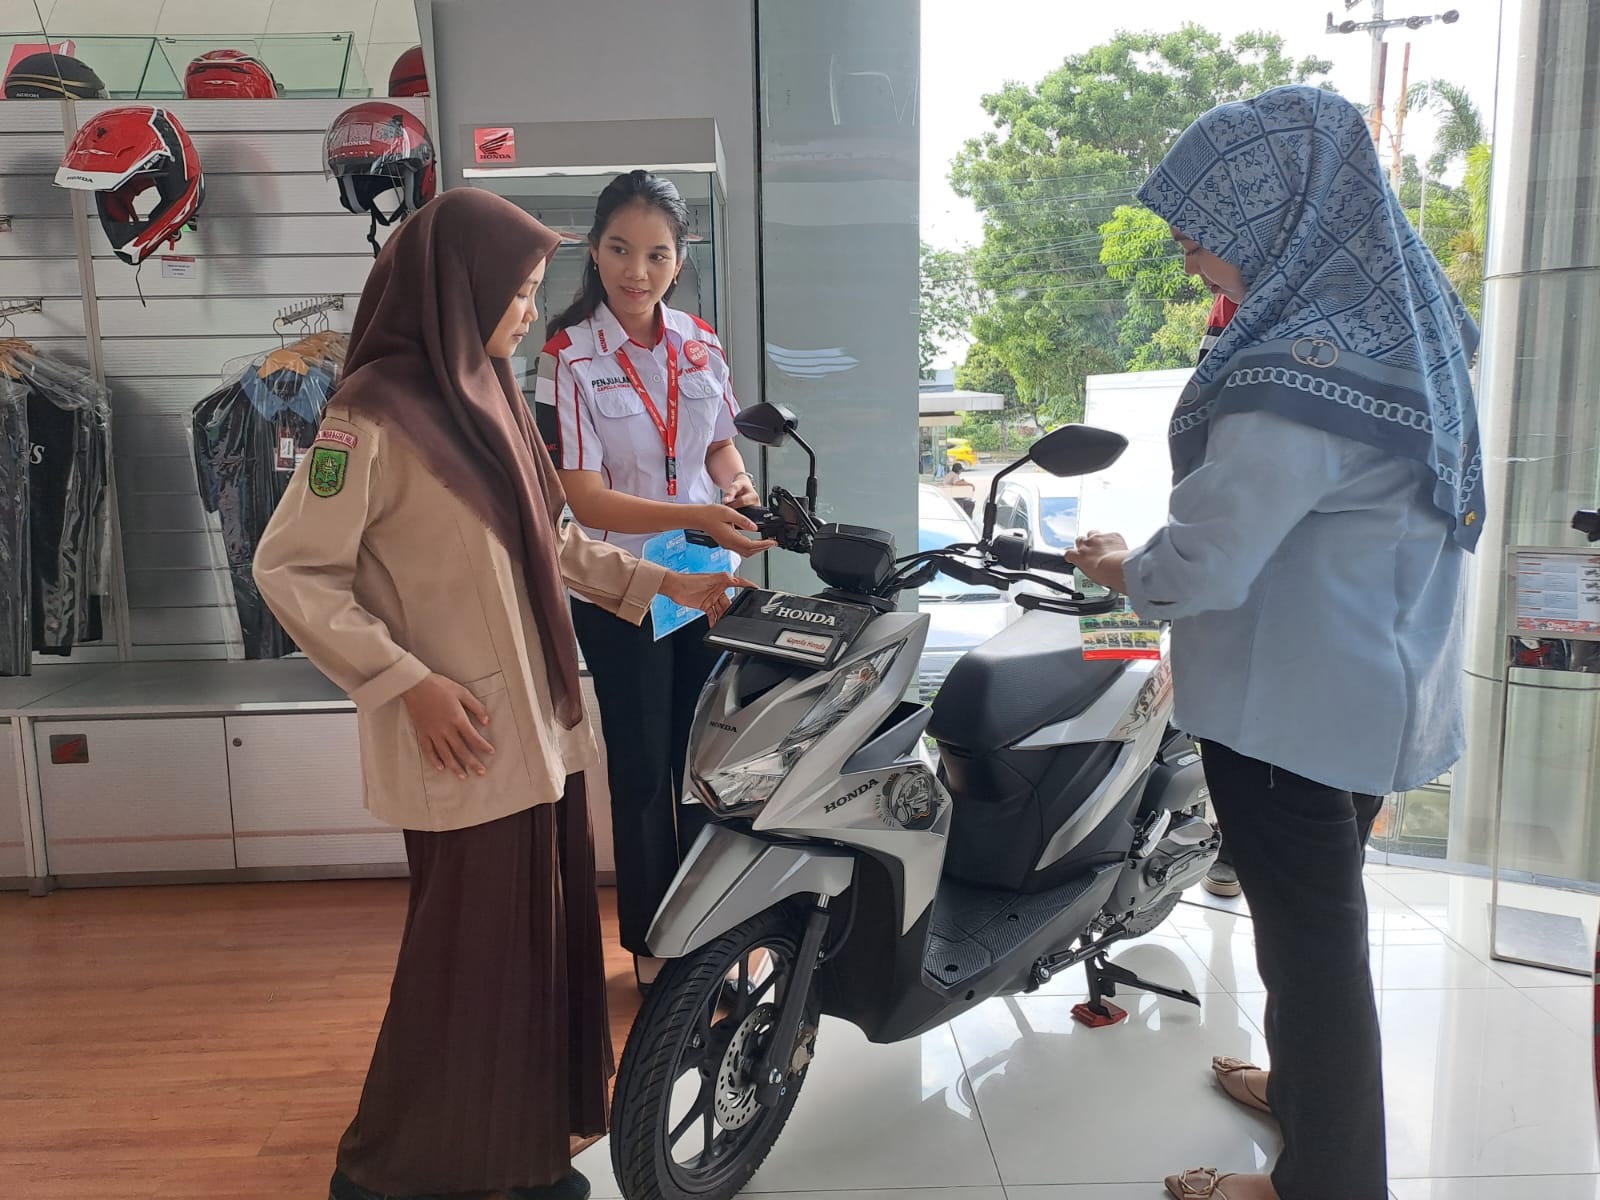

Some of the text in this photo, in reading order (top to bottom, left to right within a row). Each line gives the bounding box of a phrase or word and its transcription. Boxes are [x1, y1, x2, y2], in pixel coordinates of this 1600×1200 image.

[66, 176, 94, 184] HONDA
[776, 606, 836, 626] HONDA
[709, 720, 738, 733] HONDA
[823, 778, 880, 814] HONDA
